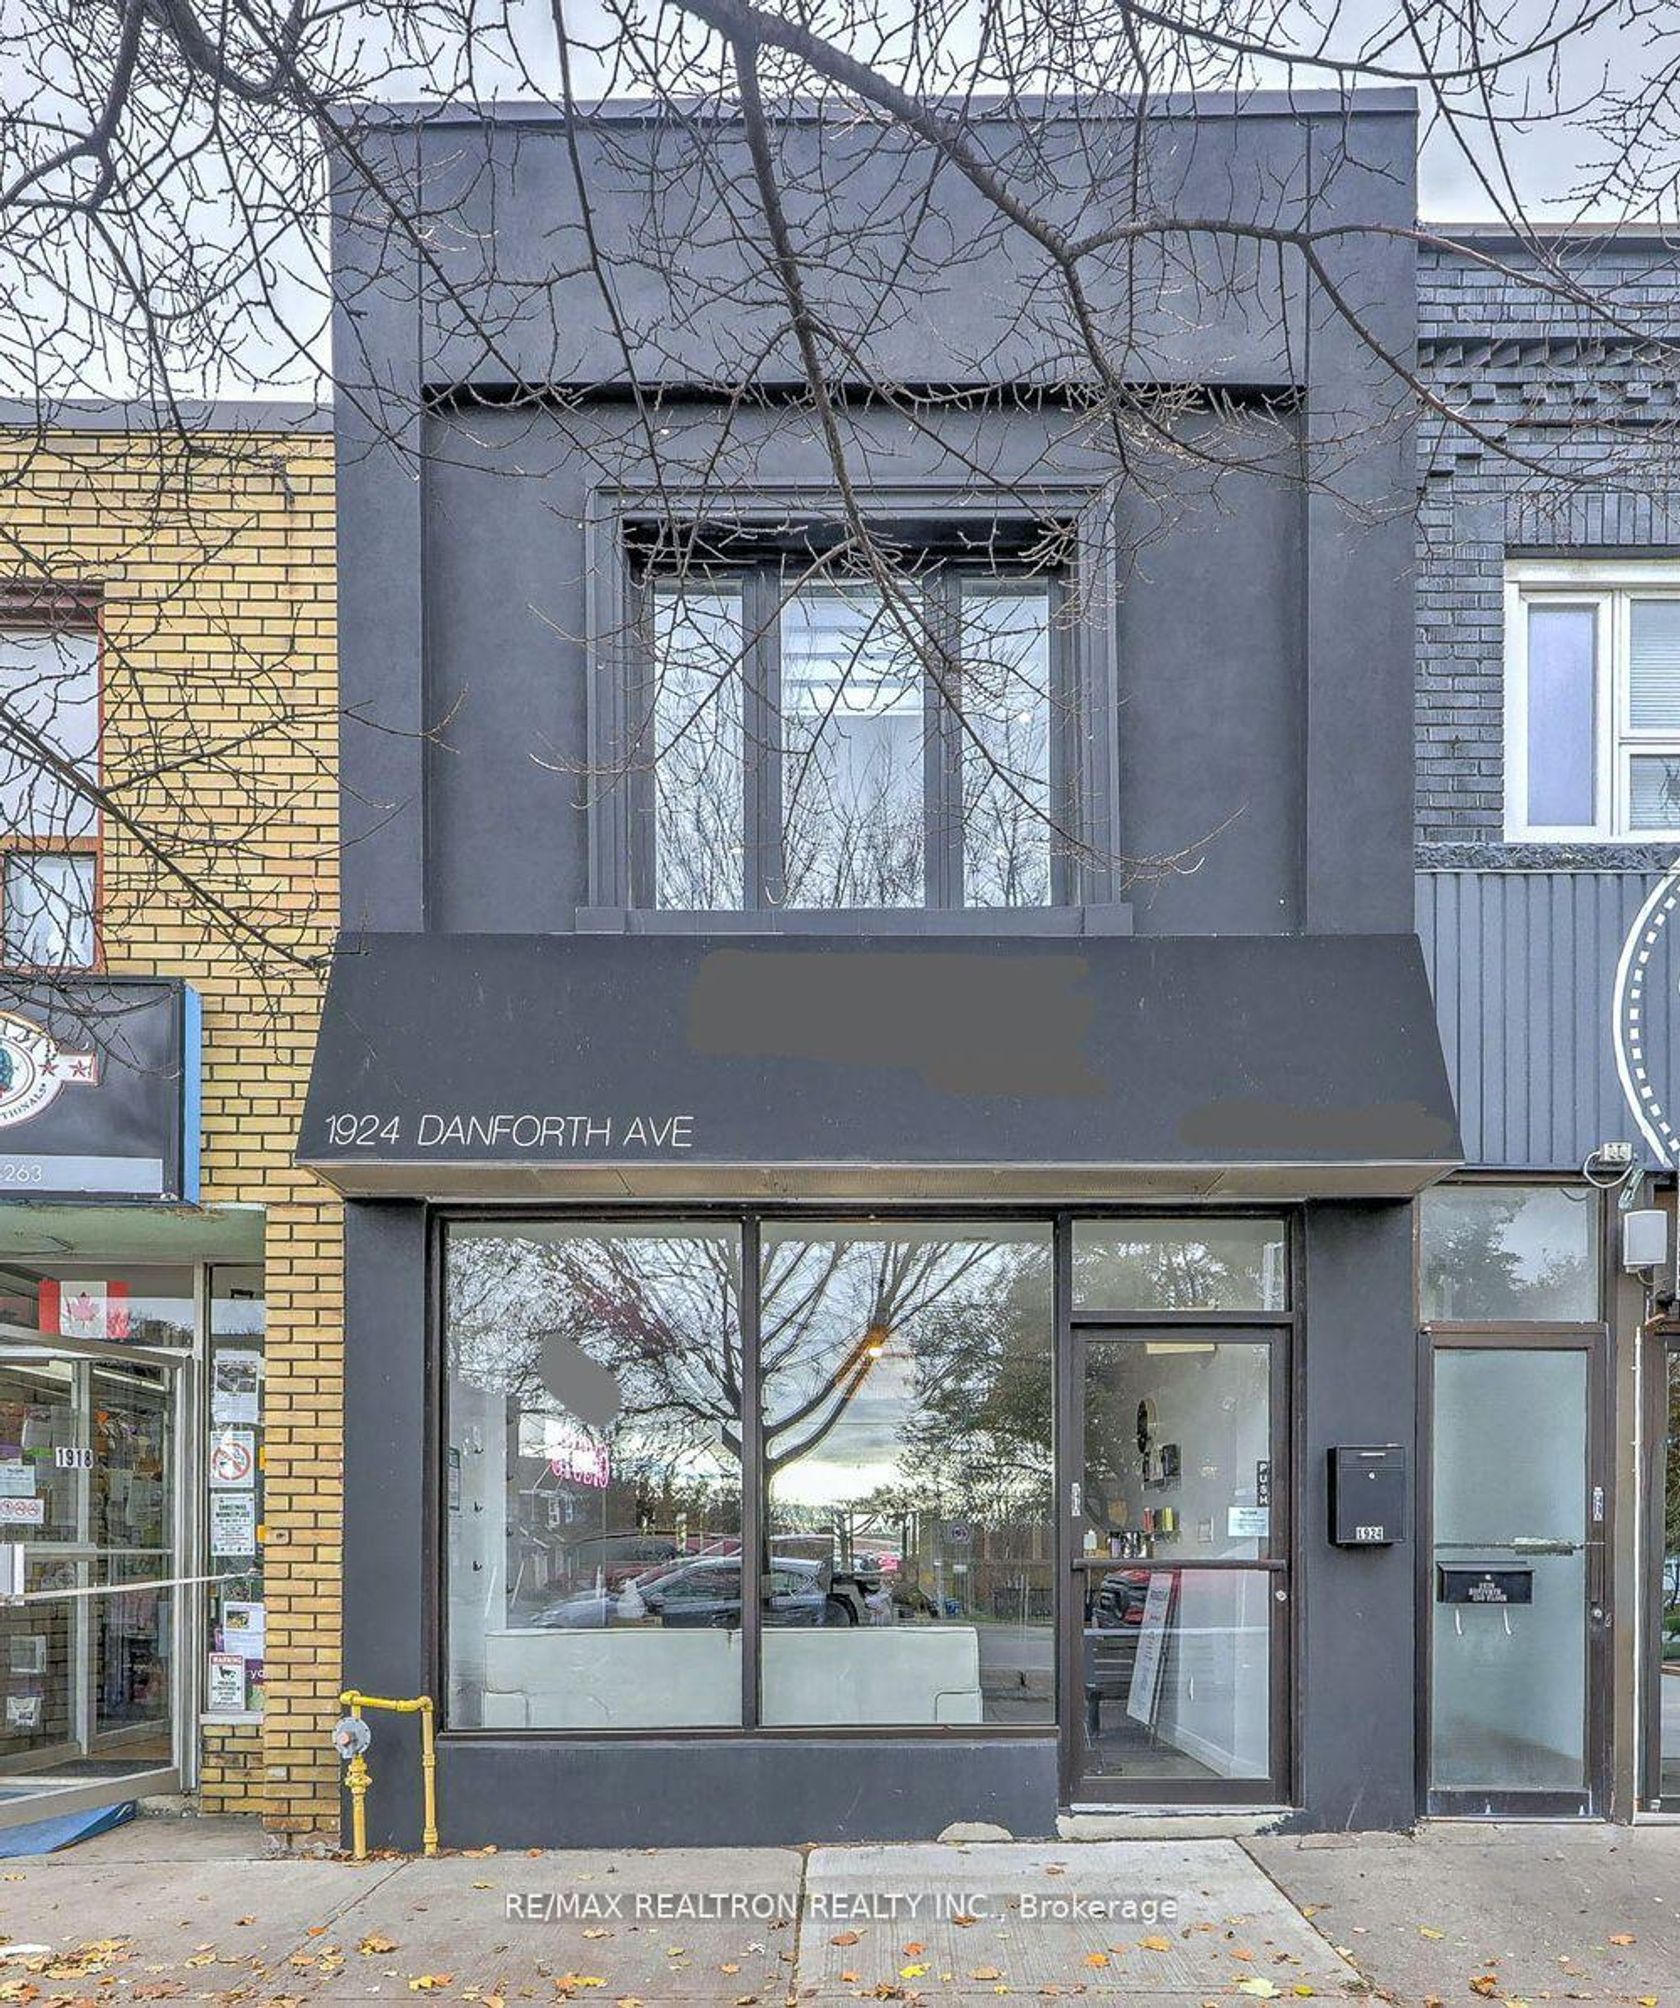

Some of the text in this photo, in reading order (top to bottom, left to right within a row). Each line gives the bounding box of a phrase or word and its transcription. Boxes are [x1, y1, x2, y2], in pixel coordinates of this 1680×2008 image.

[325, 1113, 694, 1148] 1924 DANFORTH AVE
[58, 1449, 92, 1467] 1918
[1259, 1462, 1268, 1505] PUSH
